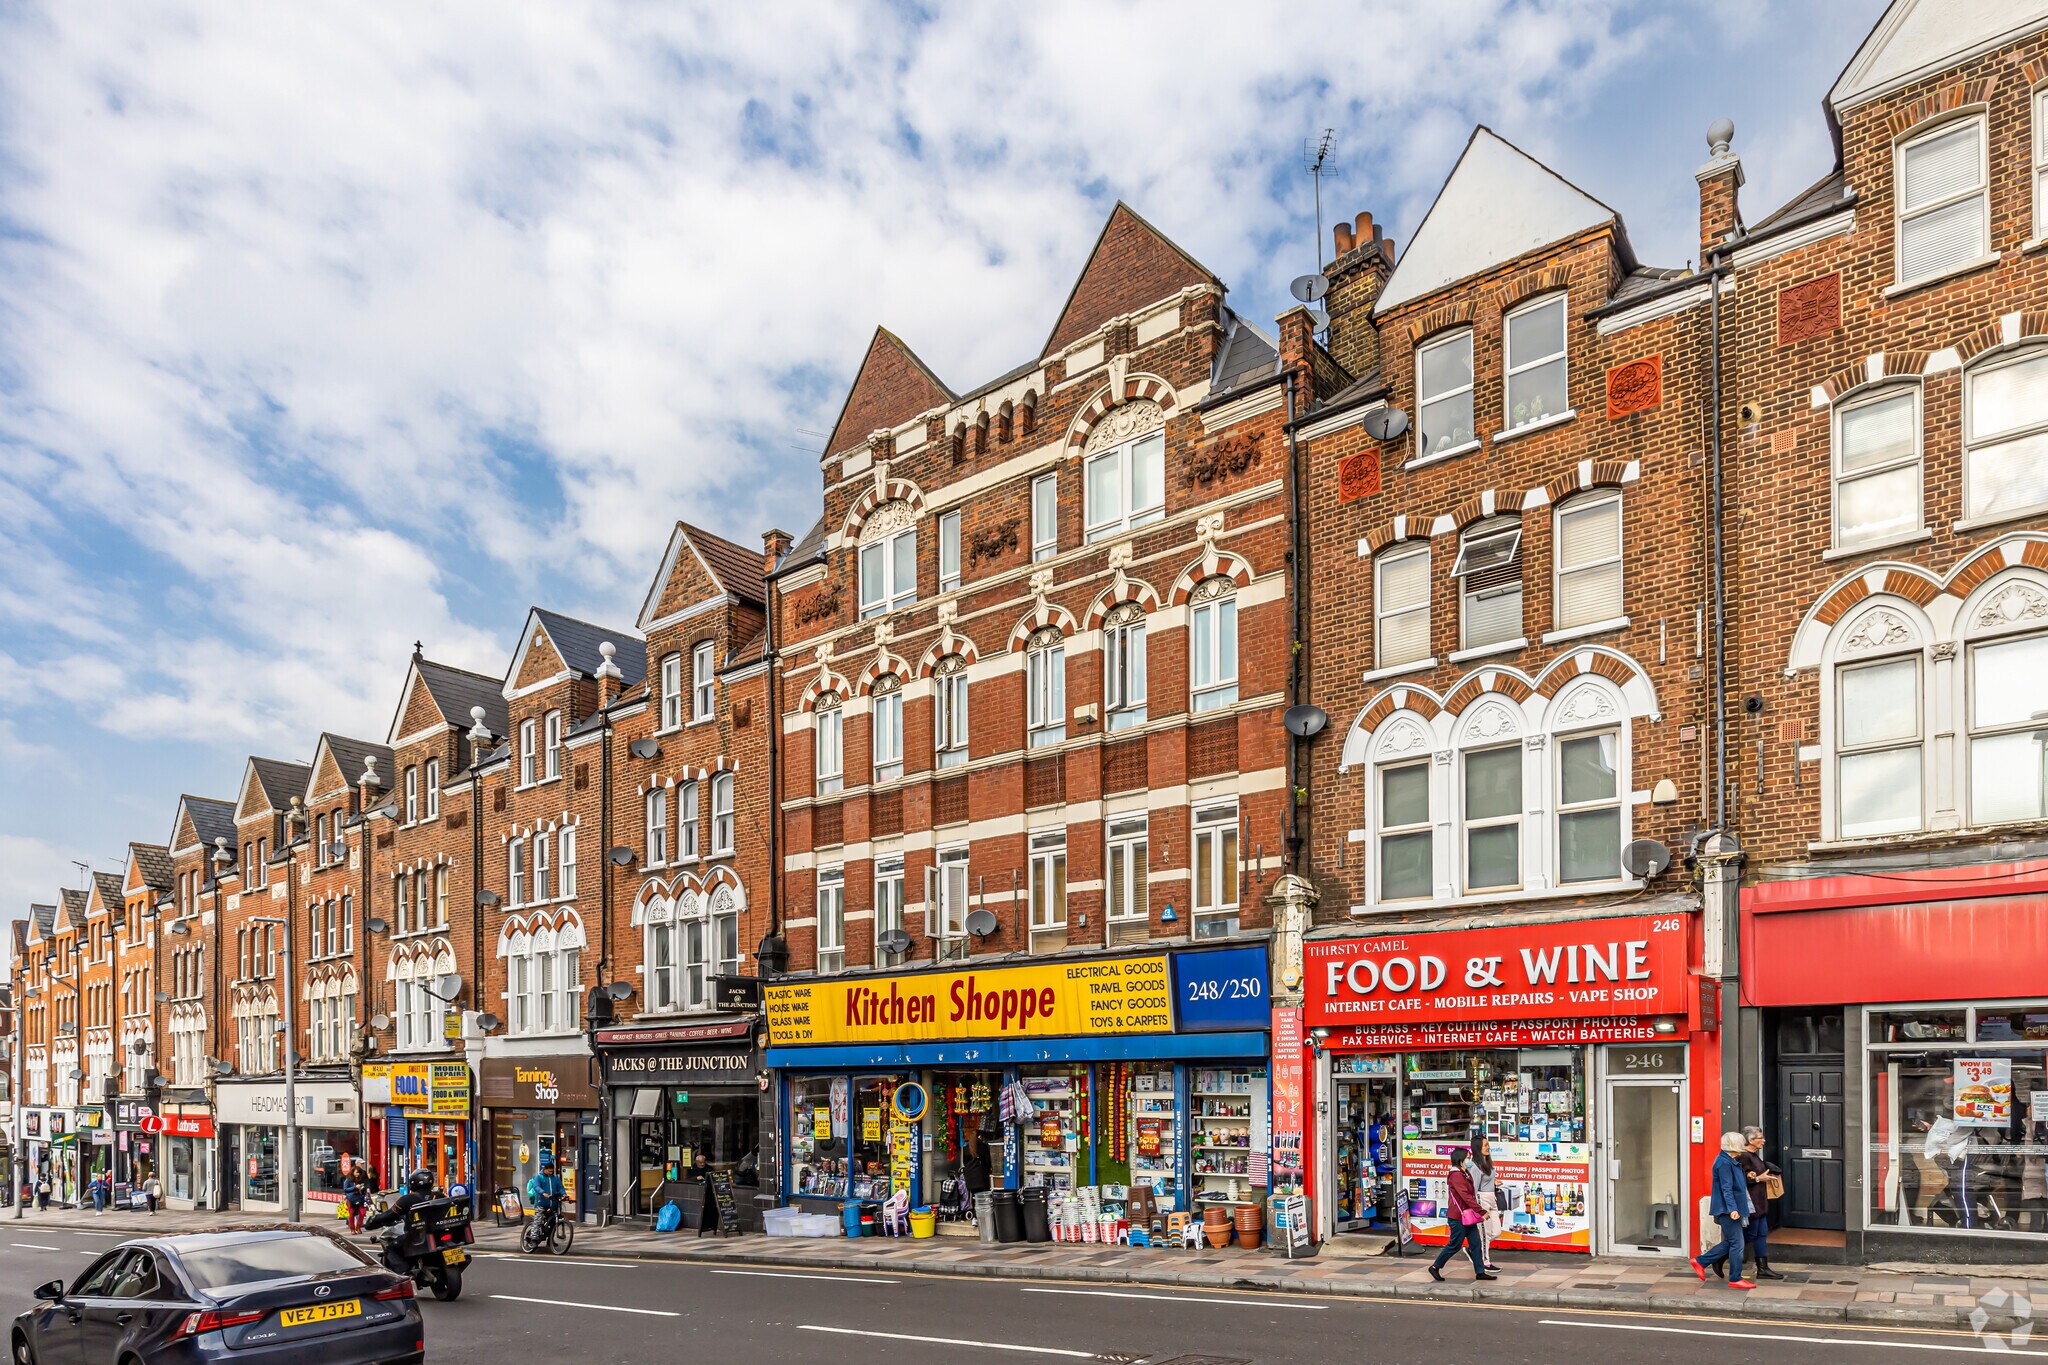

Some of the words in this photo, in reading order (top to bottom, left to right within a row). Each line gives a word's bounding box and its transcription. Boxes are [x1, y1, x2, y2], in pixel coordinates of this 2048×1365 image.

[1652, 918, 1680, 932] 246
[1308, 943, 1360, 957] THIRSTY
[1363, 940, 1409, 954] CAMEL
[1067, 964, 1121, 979] ELECTRICAL
[1124, 962, 1164, 975] GOODS
[1326, 955, 1447, 996] FOOD
[1464, 956, 1504, 989] &
[1520, 940, 1652, 985] WINE
[767, 990, 792, 1000] PLASTIC
[794, 988, 812, 998] WARE
[1090, 982, 1122, 994] TRAVEL
[1126, 980, 1165, 992] GOODS
[1188, 977, 1261, 1001] 248/250
[846, 981, 936, 1026] Kitchen
[950, 975, 1055, 1030] Shoppe
[1091, 999, 1123, 1011] FANCY
[1127, 997, 1166, 1009] GOODS
[1325, 1000, 1386, 1013] INTERNET
[1388, 998, 1421, 1011] CAFE
[1434, 995, 1488, 1009] MOBILE
[1491, 992, 1554, 1006] REPAIRS
[1569, 989, 1609, 1003] VAPE
[1613, 987, 1658, 1000] SHOP
[769, 1003, 790, 1013] HOUSE
[791, 1002, 809, 1012] WARE
[771, 1017, 792, 1027] GLASS
[793, 1016, 811, 1025] WARE
[1090, 1016, 1114, 1028] TOYS
[1115, 1016, 1124, 1027] &
[1126, 1014, 1168, 1027] CARPETS
[1355, 1025, 1378, 1035] BUS
[1380, 1024, 1409, 1034] PASS
[1420, 1023, 1443, 1033] KEY
[1447, 1021, 1498, 1032] CUTTING
[1511, 1018, 1579, 1030] PASSPORT
[1583, 1016, 1638, 1027] PHOTOS
[773, 1031, 793, 1040] TOOLS
[795, 1030, 801, 1039] &
[802, 1030, 813, 1039] DIY
[1342, 1036, 1362, 1046] FAX
[1366, 1034, 1413, 1045] SERVICE
[1425, 1032, 1481, 1044] INTERNET
[1486, 1030, 1518, 1042] CAFE
[1531, 1029, 1575, 1041] WATCH
[1580, 1027, 1655, 1040] BATTERIES
[612, 1057, 645, 1071] JACKS
[647, 1057, 657, 1073] @
[659, 1056, 684, 1071] THE
[686, 1055, 748, 1070] JUNCTION
[1624, 1053, 1664, 1069] 246
[514, 1066, 550, 1087] Tanning
[1967, 1067, 1992, 1082] £3.49
[395, 1076, 418, 1095] FOOD
[433, 1090, 447, 1099] FOOD
[453, 1089, 468, 1098] WINE
[535, 1083, 559, 1104] Shop
[1805, 1095, 1827, 1103] 244A
[815, 1120, 831, 1128] SOLD
[865, 1121, 880, 1129] SOLD
[1041, 1129, 1061, 1137] SOLD
[1139, 1136, 1160, 1145] SOLD
[286, 1308, 316, 1324] VEZ
[318, 1301, 355, 1318] 7373
[247, 1332, 278, 1340] LEXUS
